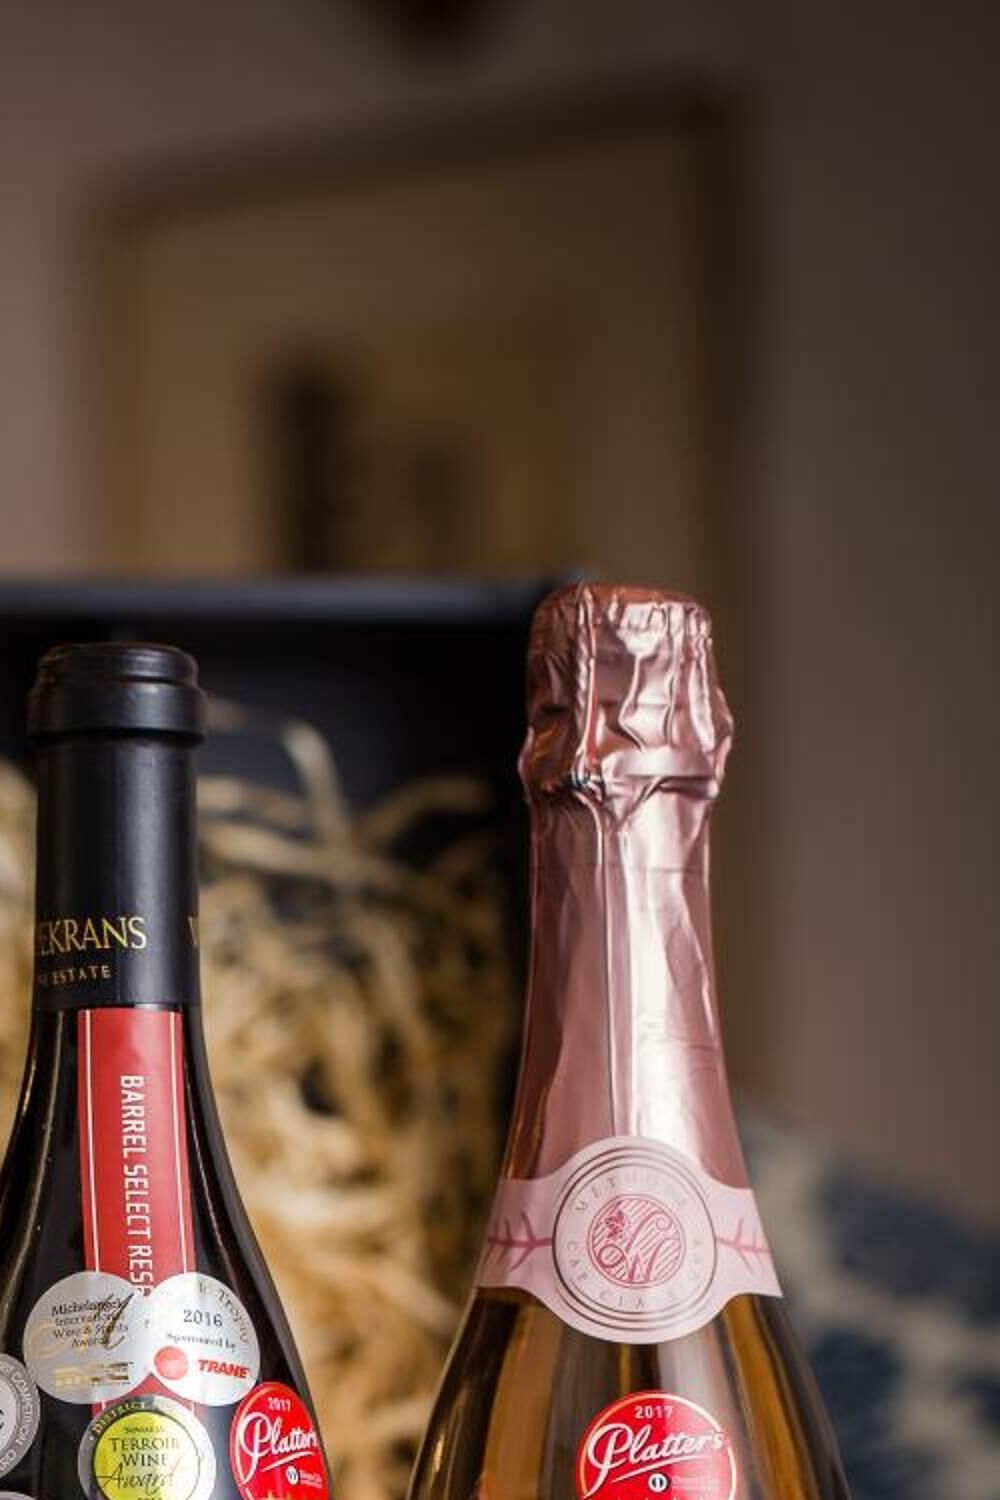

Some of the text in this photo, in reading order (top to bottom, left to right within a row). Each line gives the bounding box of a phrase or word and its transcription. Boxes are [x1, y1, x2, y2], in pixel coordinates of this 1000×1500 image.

[52, 965, 112, 985] ESTATE
[120, 1075, 147, 1159] BARREL
[123, 1163, 151, 1239] SELECT
[182, 1309, 224, 1329] 2016
[197, 1359, 249, 1380] TRANE
[635, 1405, 674, 1420] 2017
[121, 1453, 169, 1467] WINE
